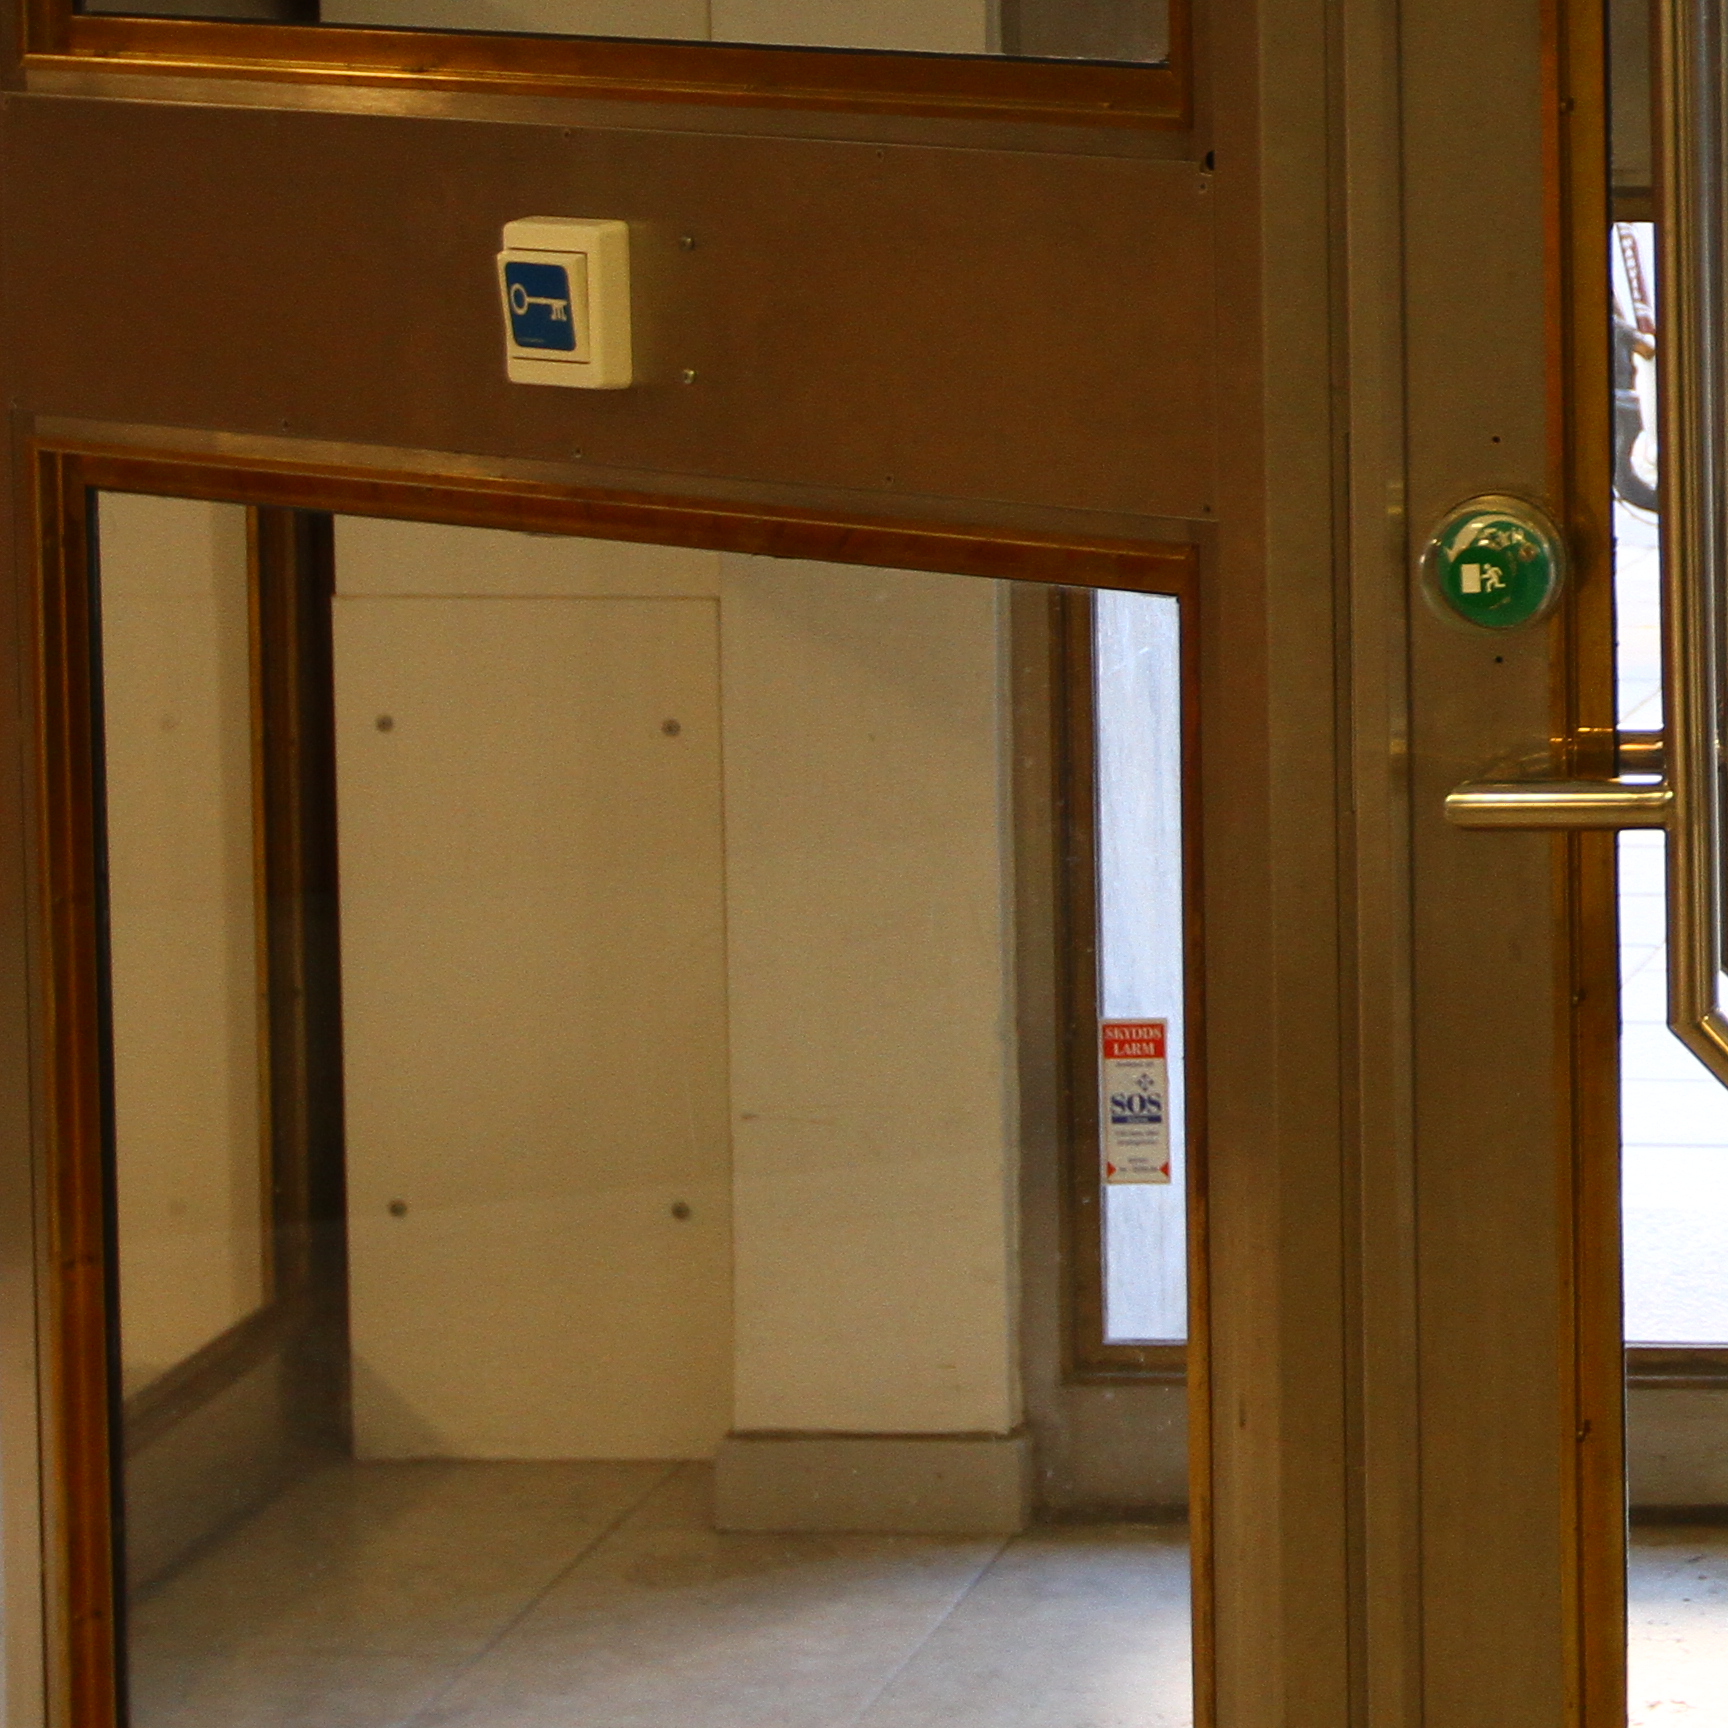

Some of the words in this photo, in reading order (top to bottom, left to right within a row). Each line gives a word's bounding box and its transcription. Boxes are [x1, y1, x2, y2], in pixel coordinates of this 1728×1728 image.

[1104, 1027, 1162, 1040] SKYDDS
[1113, 1042, 1155, 1055] LARM
[1111, 1092, 1162, 1114] SOS
